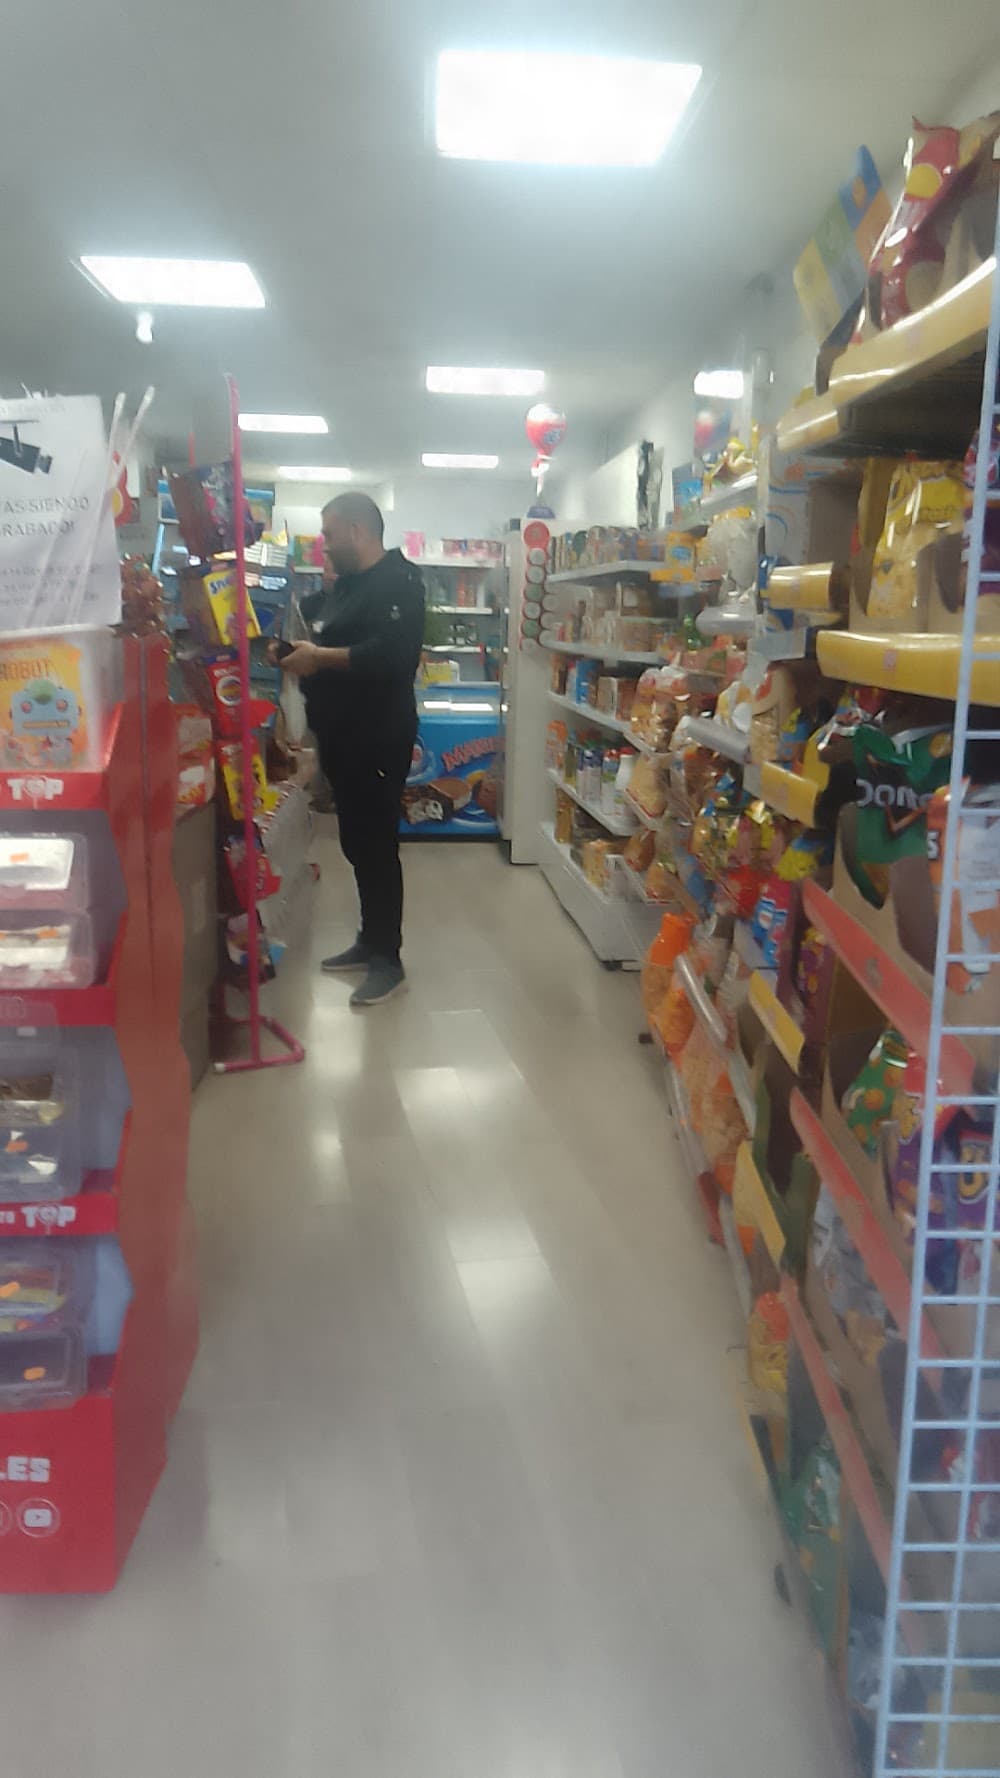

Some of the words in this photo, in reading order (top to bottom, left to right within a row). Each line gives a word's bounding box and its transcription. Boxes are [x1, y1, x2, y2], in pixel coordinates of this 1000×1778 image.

[0, 520, 74, 537] RABADO!
[7, 775, 64, 801] TOP
[21, 1204, 76, 1228] TOP
[0, 1455, 50, 1483] ES
